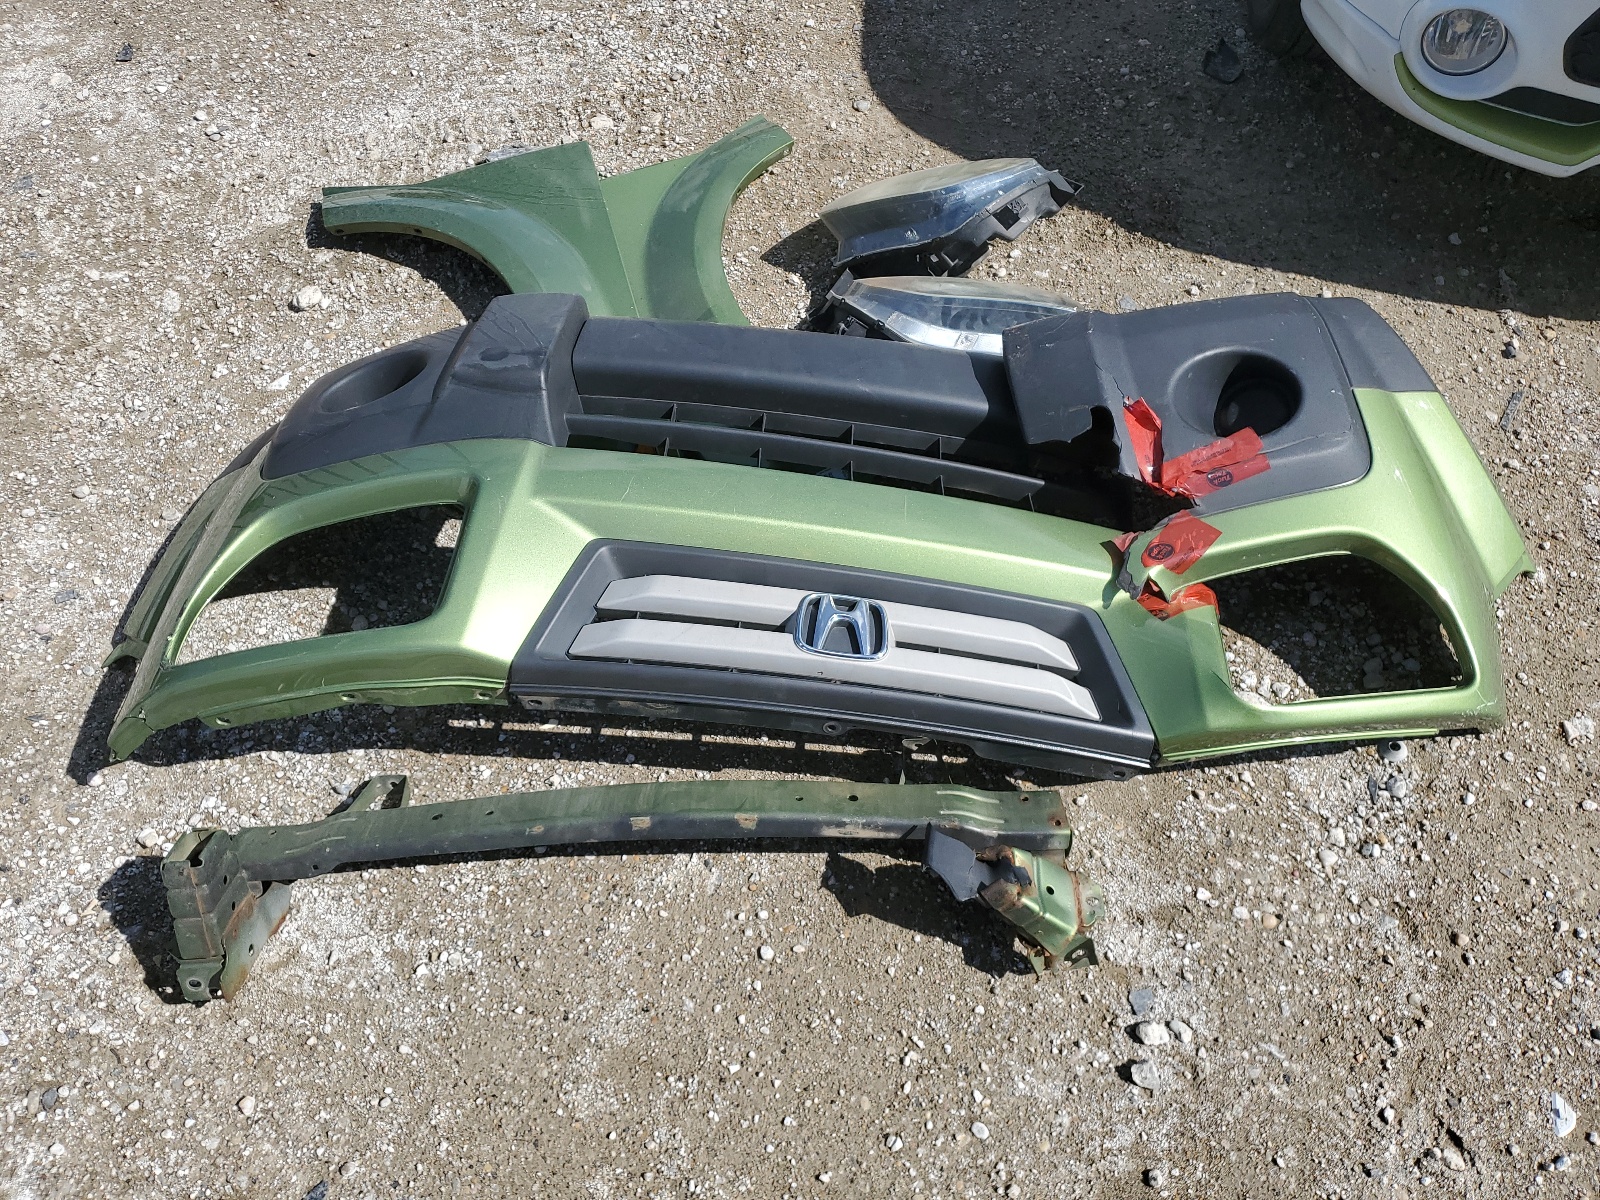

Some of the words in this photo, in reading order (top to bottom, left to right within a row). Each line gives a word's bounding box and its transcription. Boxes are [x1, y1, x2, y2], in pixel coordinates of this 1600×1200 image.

[1212, 474, 1231, 486] Tuck
[1150, 544, 1165, 557] Tape
[1156, 545, 1171, 560] Tuck
